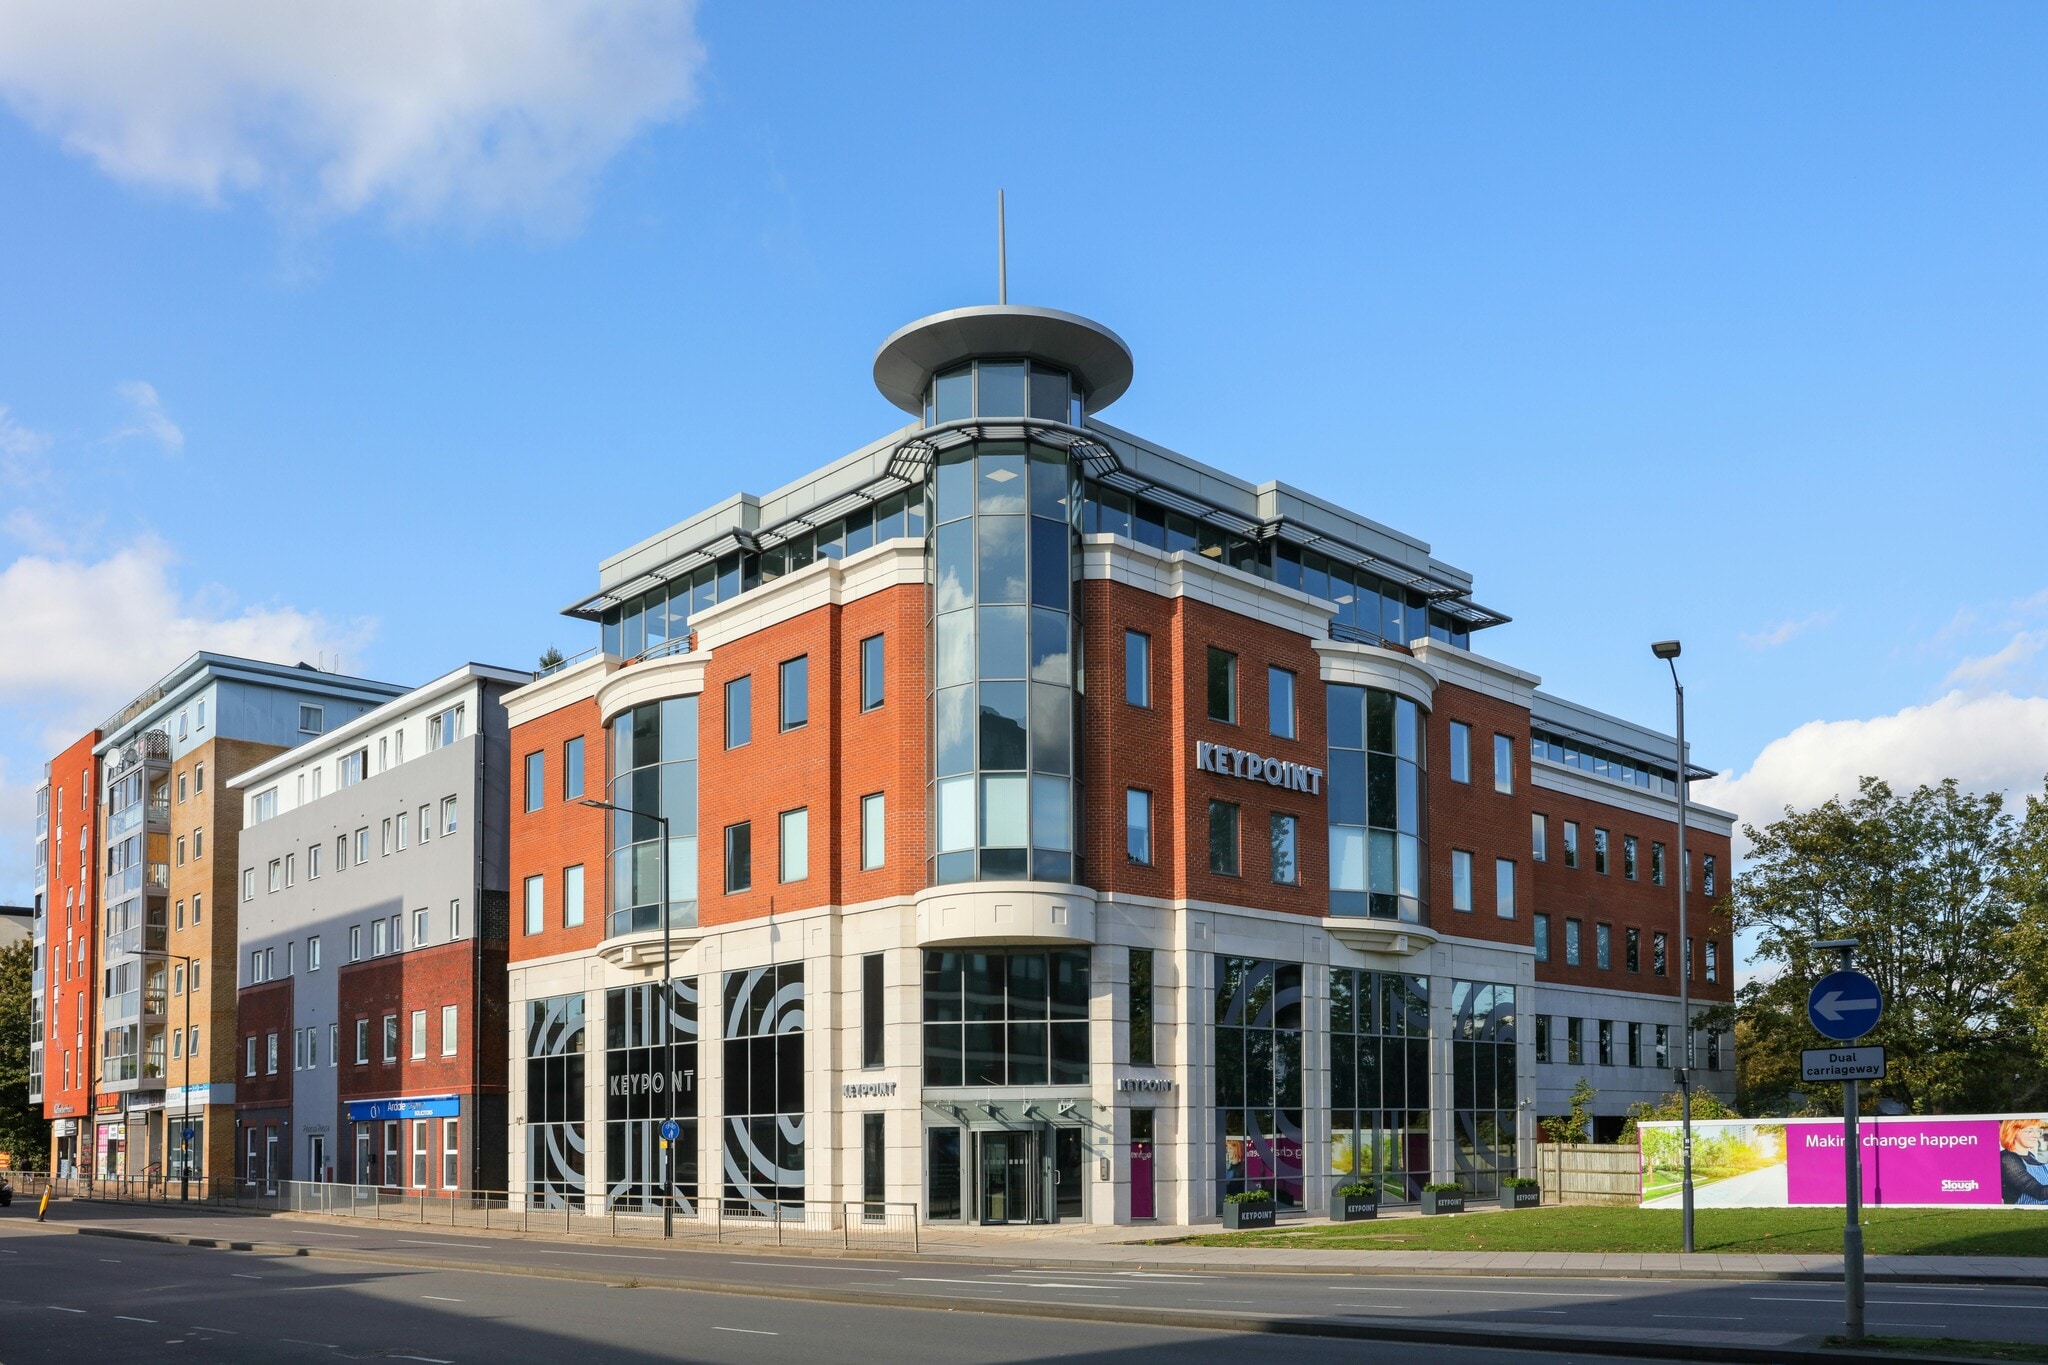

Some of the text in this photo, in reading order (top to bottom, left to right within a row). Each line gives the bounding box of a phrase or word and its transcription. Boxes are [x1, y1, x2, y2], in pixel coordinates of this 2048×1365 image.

[1196, 740, 1322, 795] KEYPOINT
[1829, 1053, 1857, 1063] Dual
[1806, 1065, 1880, 1076] carriageway
[610, 1069, 694, 1096] KEYPONT
[1117, 1079, 1174, 1092] KEYPOINT
[843, 1082, 897, 1098] KEYPOINT
[1806, 1133, 1978, 1149] Maki change happen
[1941, 1179, 1979, 1191] Slough
[1348, 1204, 1375, 1213] KEYPOINT
[1241, 1211, 1273, 1220] KEYPOINT
